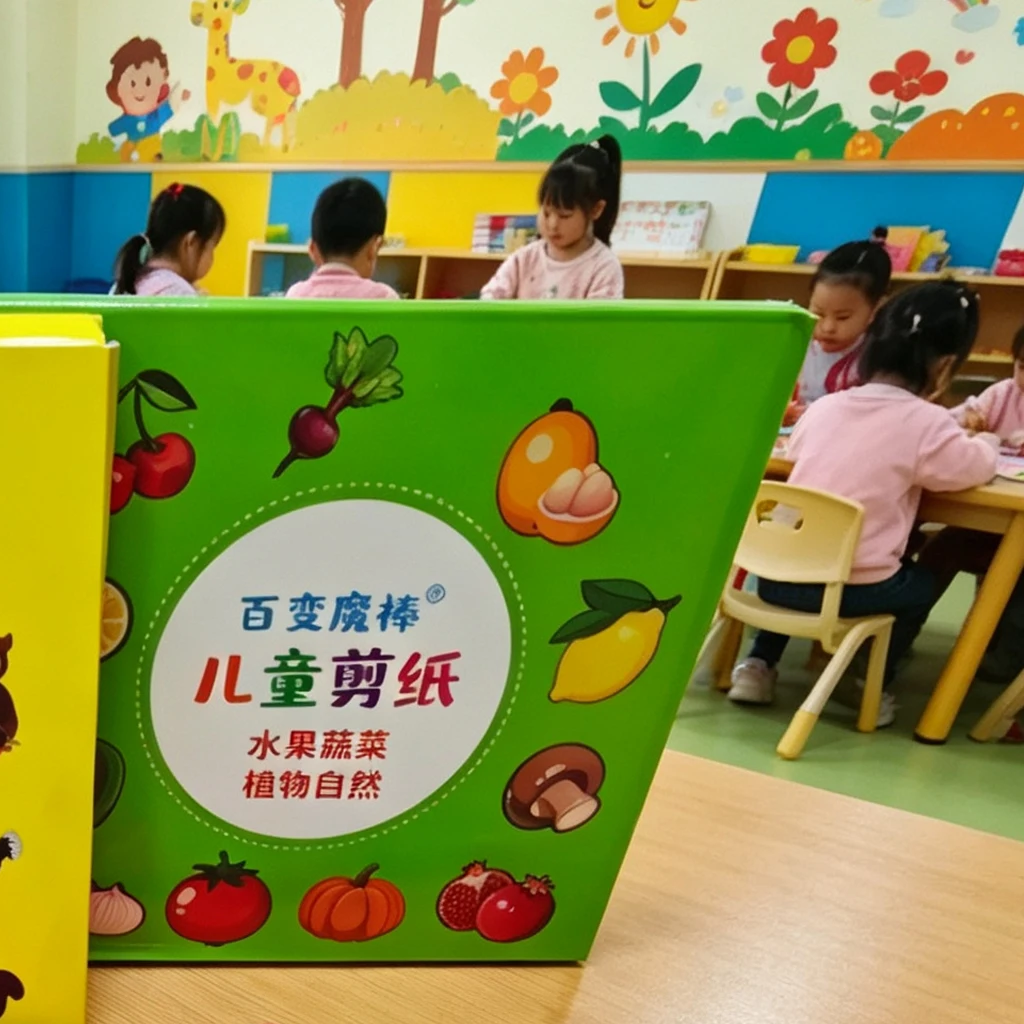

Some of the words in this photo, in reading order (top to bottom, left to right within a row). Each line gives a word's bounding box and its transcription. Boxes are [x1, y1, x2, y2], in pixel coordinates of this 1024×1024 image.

[241, 591, 421, 633] 百变魔棒
[194, 648, 461, 709] 儿童剪纸
[247, 729, 390, 760] 水果蔬菜
[242, 769, 384, 800] 植物自然
